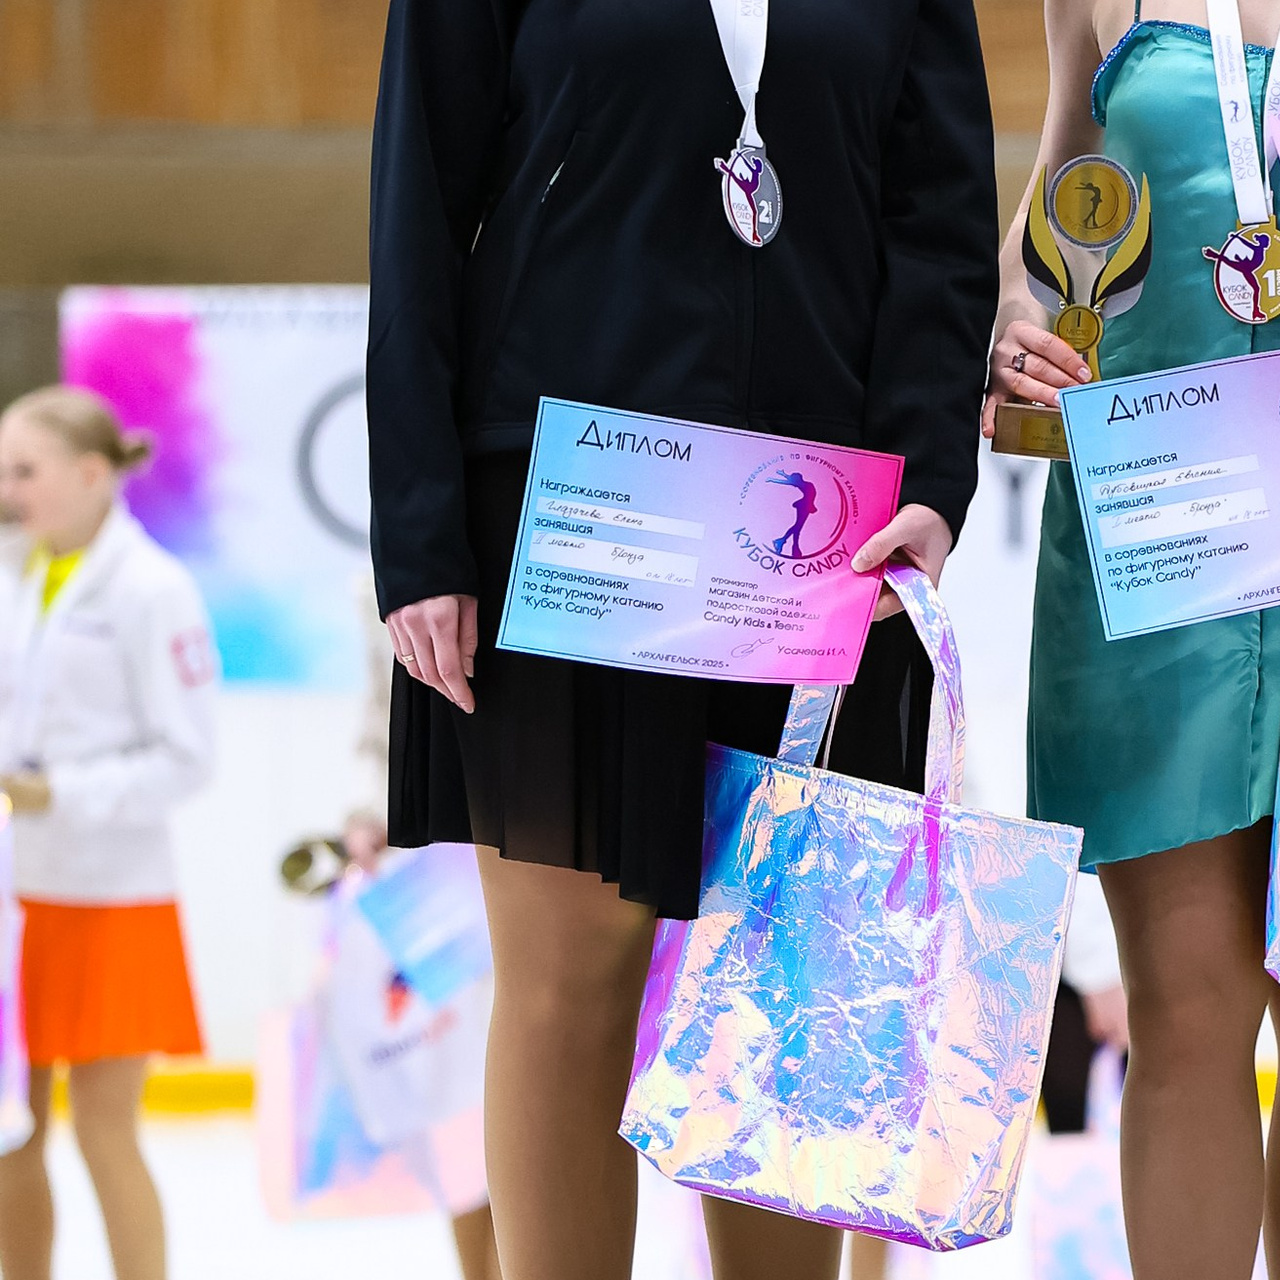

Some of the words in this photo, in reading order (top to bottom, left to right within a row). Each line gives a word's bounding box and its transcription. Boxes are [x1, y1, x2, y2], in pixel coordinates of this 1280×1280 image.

[759, 200, 770, 223] 2
[1262, 269, 1276, 297] 1
[1087, 452, 1178, 477] Награждается
[540, 478, 631, 503] Награждается
[1095, 495, 1154, 514] занявшая
[534, 517, 593, 535] занявшая
[733, 527, 785, 576] КУБОК
[792, 543, 850, 577] CANDY
[1104, 553, 1112, 563] в
[1114, 534, 1209, 561] соревнованиях
[1108, 566, 1123, 578] по
[1125, 552, 1195, 575] фигурному
[1197, 542, 1249, 560] катанию
[525, 566, 533, 575] в
[535, 568, 630, 591] соревнованиях
[522, 580, 538, 591] по
[540, 582, 611, 606] фигурному
[612, 595, 664, 612] катанию
[708, 587, 750, 600] магазин
[751, 593, 794, 607] детской
[703, 611, 741, 627] Candy
[743, 616, 765, 629] Kids
[774, 620, 805, 632] Teens
[706, 599, 779, 616] подростковой
[780, 609, 821, 621] одежды
[637, 650, 700, 666] АРХАНГЕЛЬСК
[701, 658, 724, 668] 2025
[777, 645, 825, 656] Усачева
